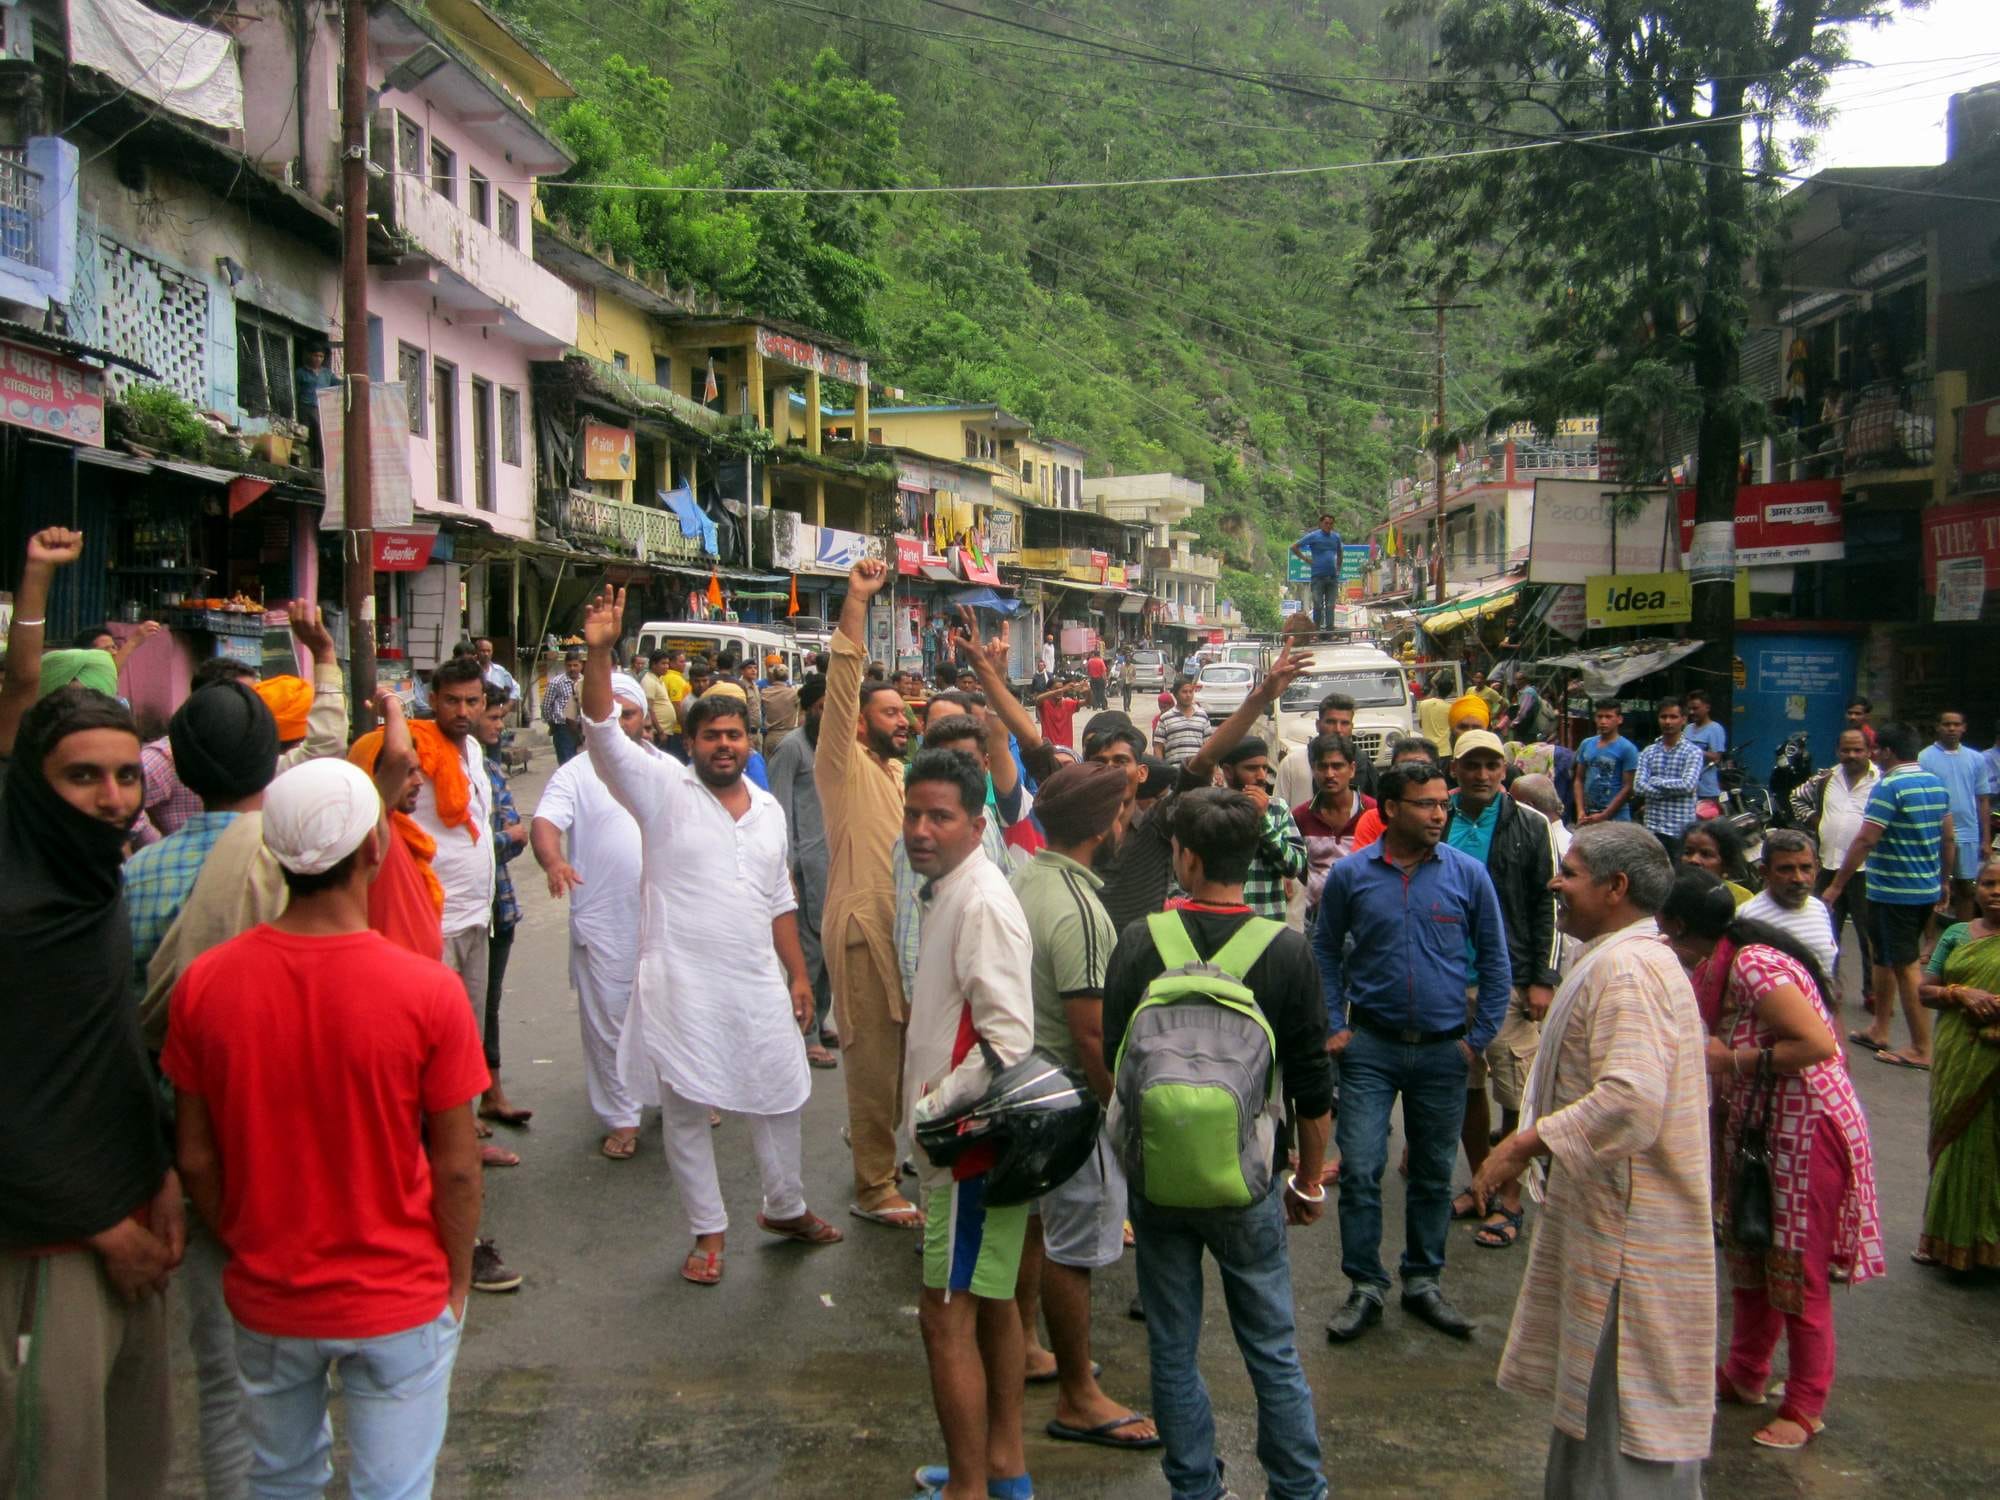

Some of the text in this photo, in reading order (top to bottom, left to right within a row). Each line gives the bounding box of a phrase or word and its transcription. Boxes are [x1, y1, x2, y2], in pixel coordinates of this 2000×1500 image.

[3, 376, 54, 403] शाकाहारी
[57, 365, 82, 400] फूड
[1770, 504, 1824, 517] अमर उजाला
[1930, 521, 1977, 557] THE
[903, 544, 920, 565] airtel
